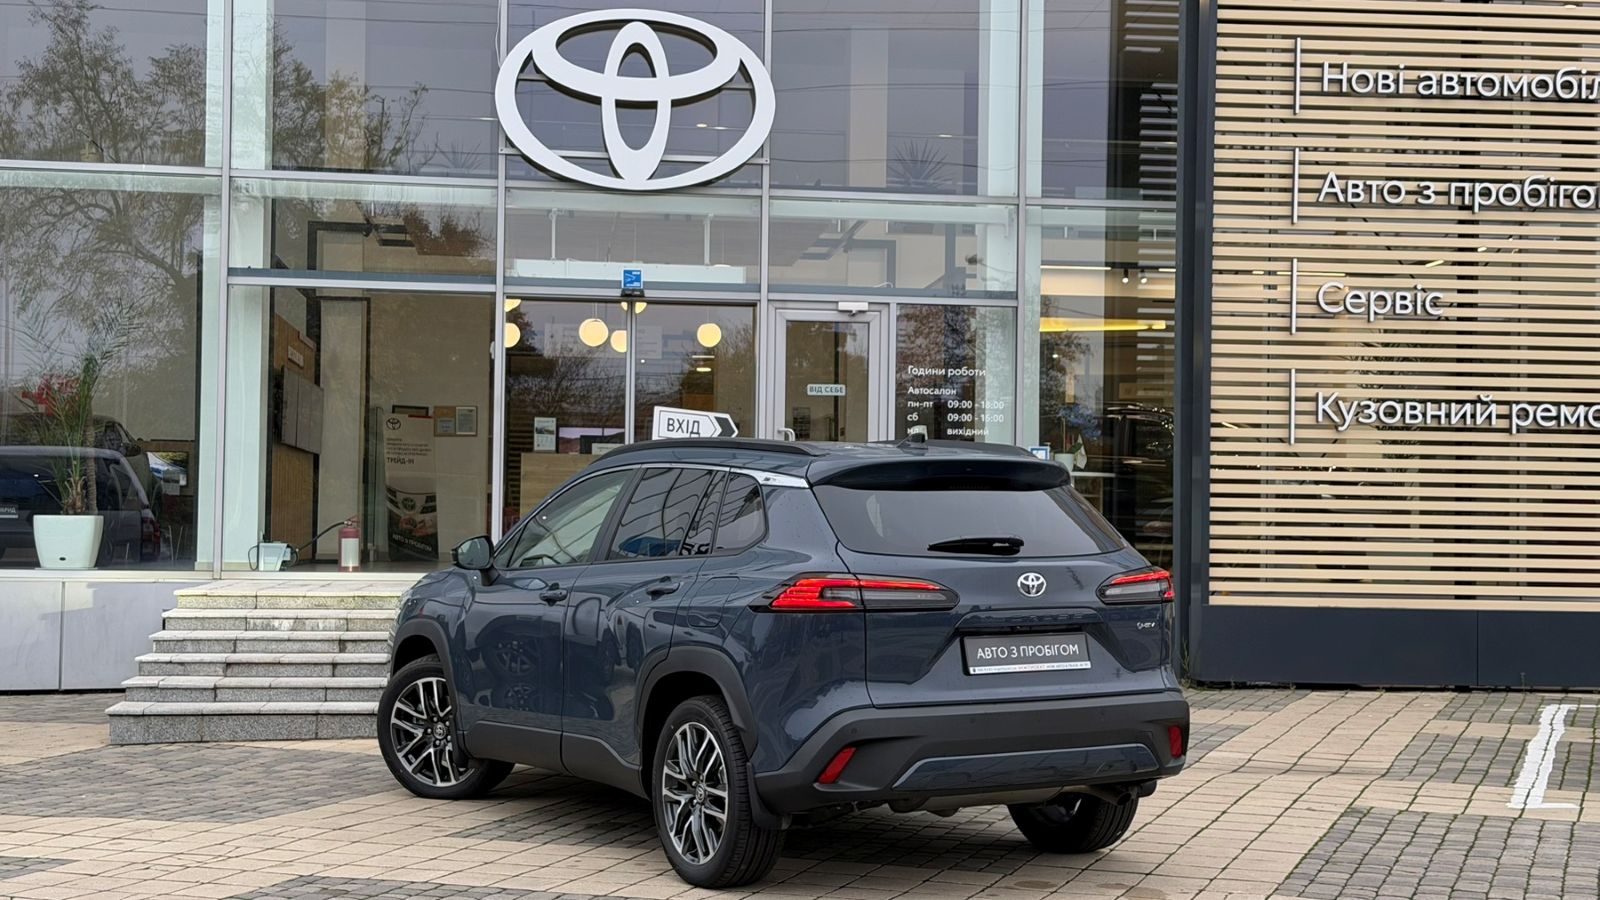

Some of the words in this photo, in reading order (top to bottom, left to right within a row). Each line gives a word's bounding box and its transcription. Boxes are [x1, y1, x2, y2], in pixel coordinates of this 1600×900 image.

[1321, 61, 1405, 95] Нові
[1318, 171, 1406, 204] Авто
[1417, 180, 1436, 204] з
[1450, 175, 1600, 214] пробіго
[1317, 281, 1444, 322] Сервіс
[908, 366, 945, 376] Години
[948, 366, 985, 378] роботи
[809, 386, 823, 394] ВІД
[824, 386, 843, 394] СЕБЕ
[907, 386, 956, 395] Автосалон
[947, 400, 973, 409] 09:00
[981, 401, 1004, 409] 18:00
[907, 412, 919, 421] сб
[947, 413, 973, 422] 09:00
[1317, 391, 1497, 431] Кузовний
[1511, 403, 1600, 434] ремо
[666, 417, 700, 437] ВХІД
[947, 426, 989, 436] вихідний
[977, 646, 1008, 659] АВТО
[1010, 645, 1018, 658] З
[1020, 644, 1079, 658] ПРОБІГОМ
